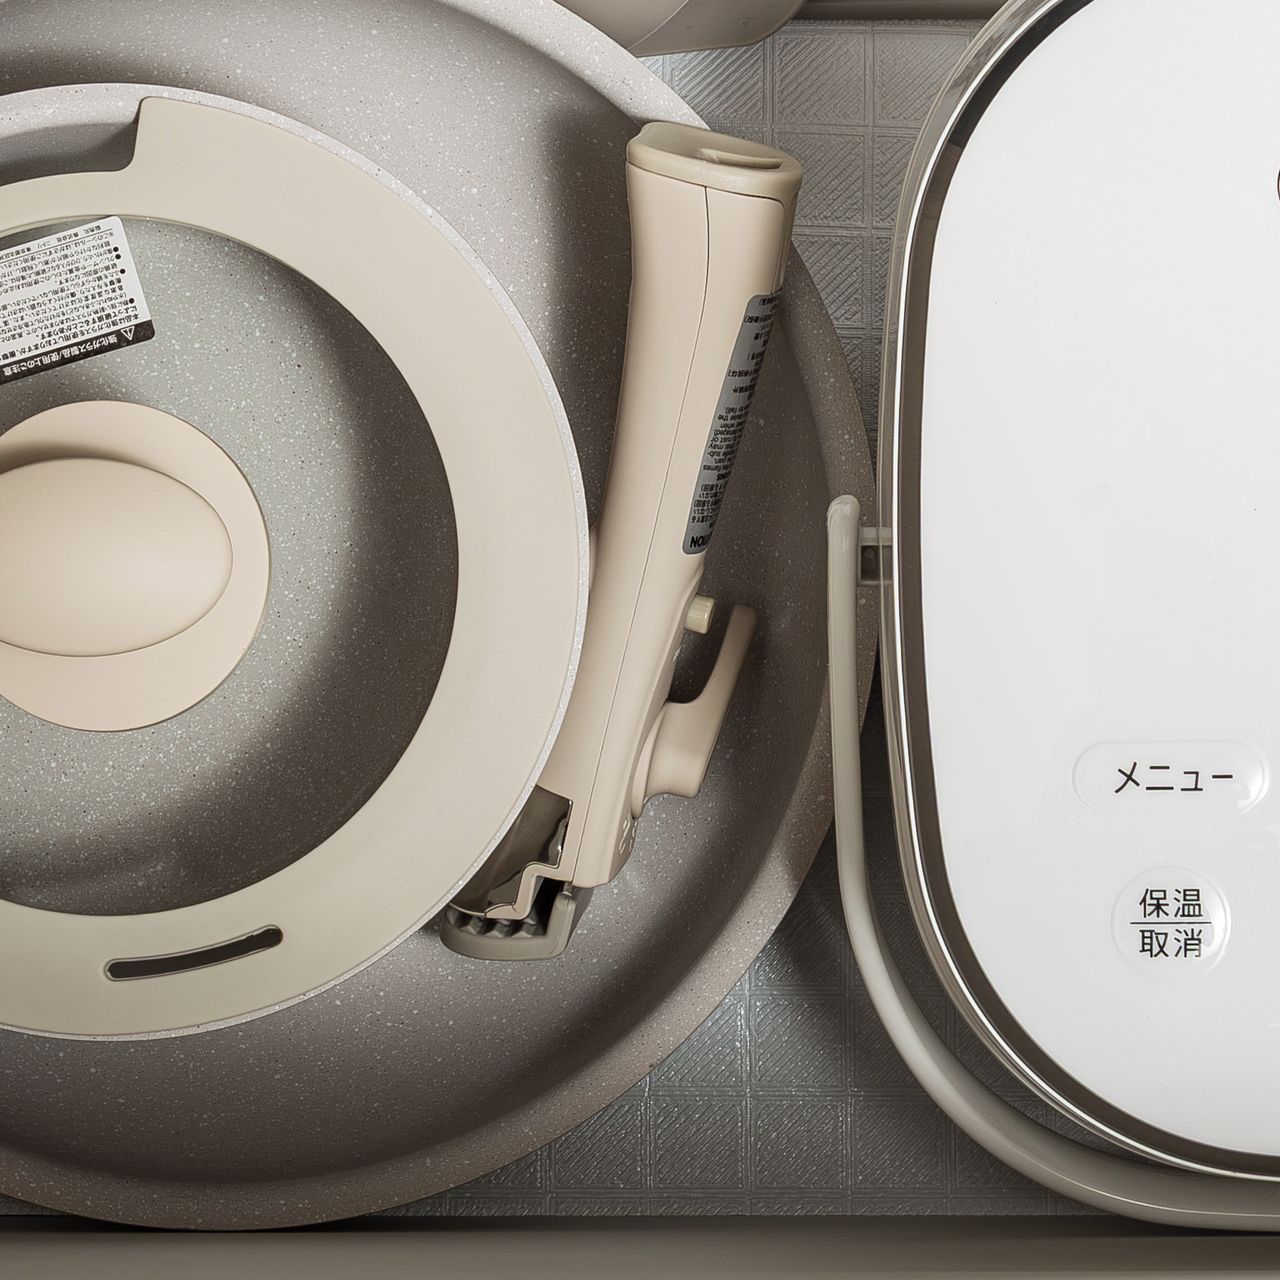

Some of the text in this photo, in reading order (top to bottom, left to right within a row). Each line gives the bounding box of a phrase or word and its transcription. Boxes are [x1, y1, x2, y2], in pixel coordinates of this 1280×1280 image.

[1114, 761, 1233, 794] メニュー
[1139, 888, 1203, 918] 保温
[1139, 929, 1201, 958] 取消
